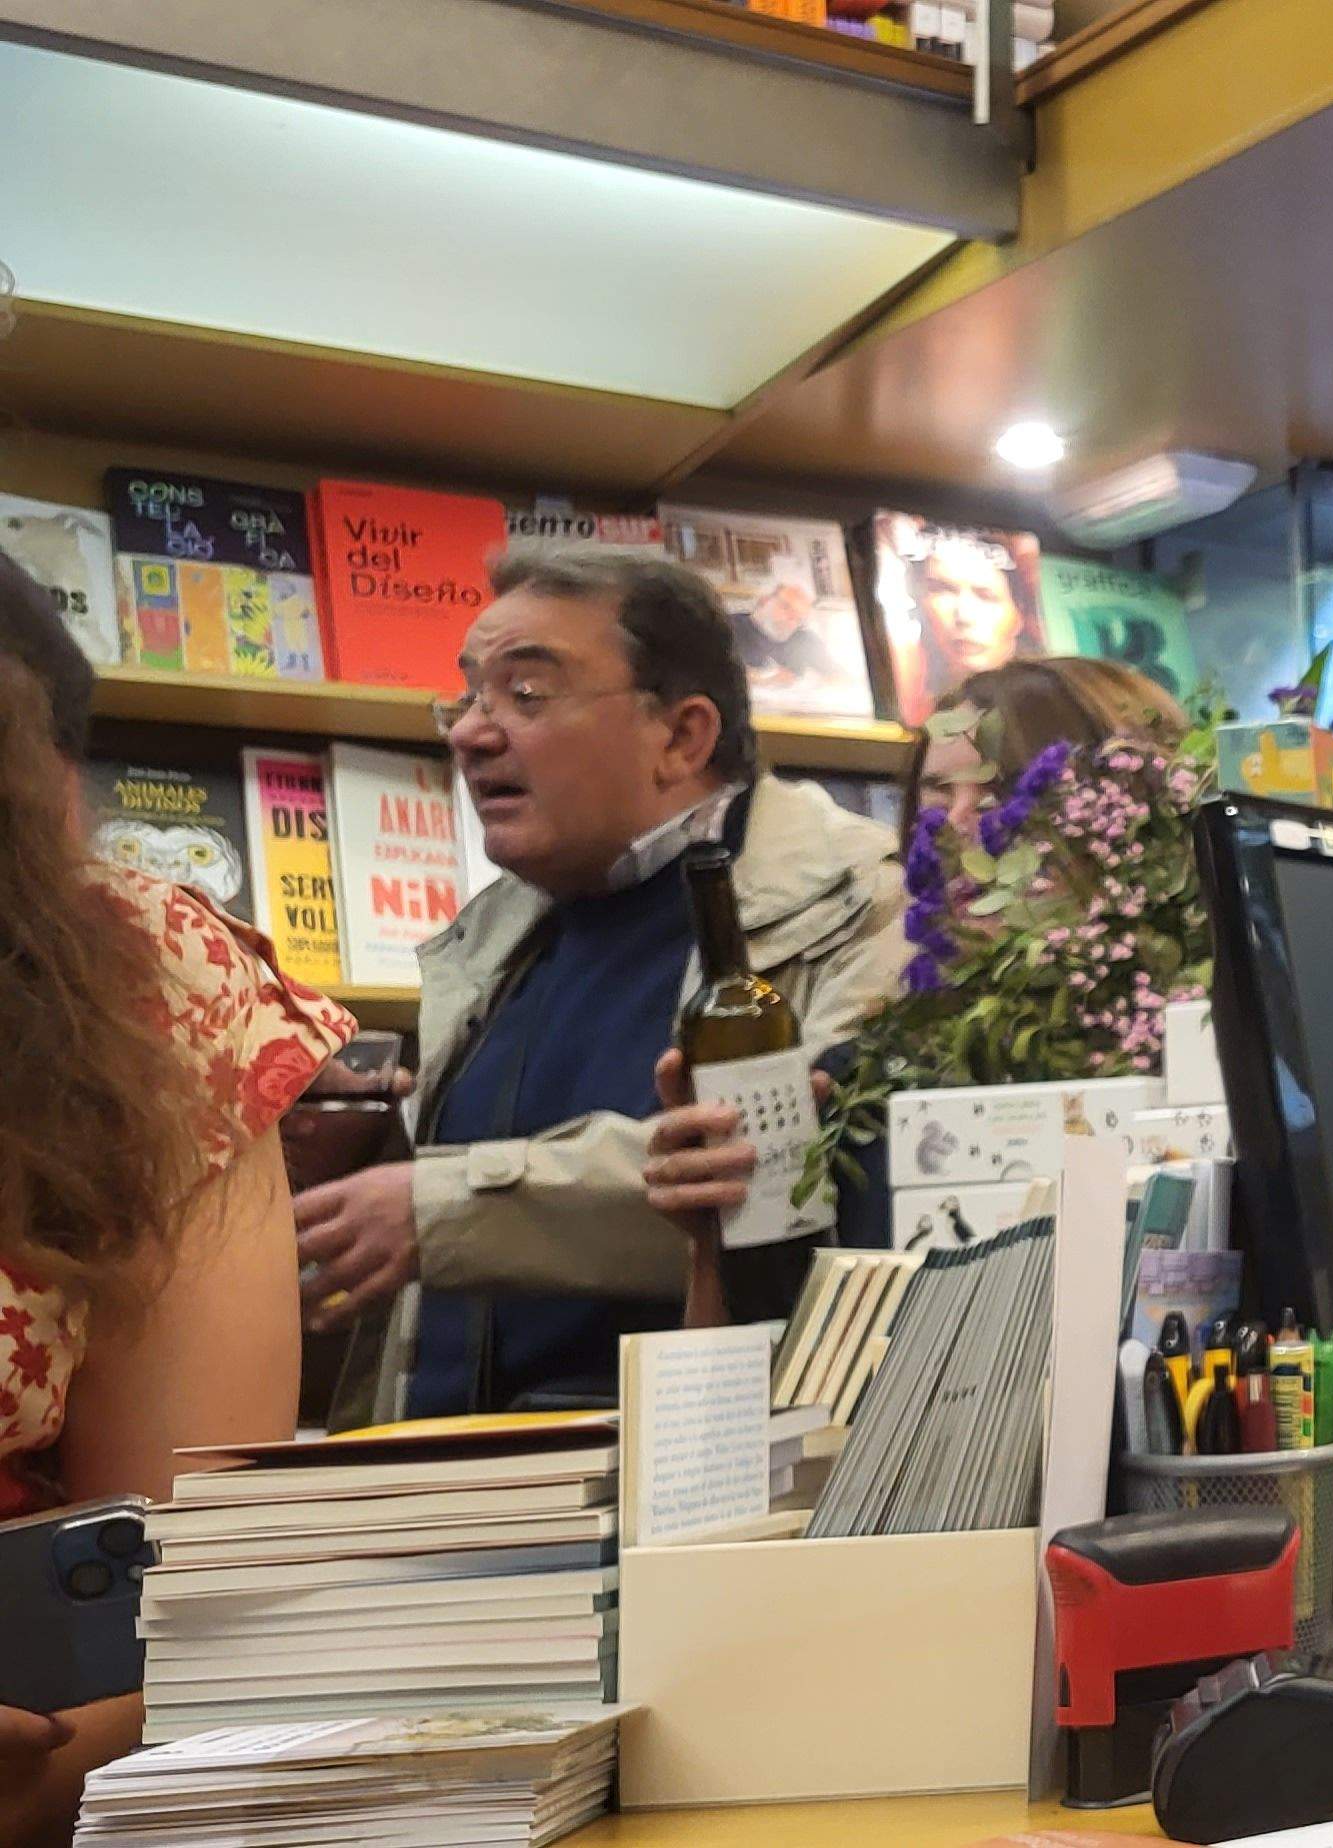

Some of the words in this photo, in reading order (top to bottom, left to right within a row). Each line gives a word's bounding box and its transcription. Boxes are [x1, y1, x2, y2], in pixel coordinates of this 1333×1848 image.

[343, 515, 423, 547] Vivir
[347, 545, 401, 572] del
[351, 571, 482, 608] Diseño
